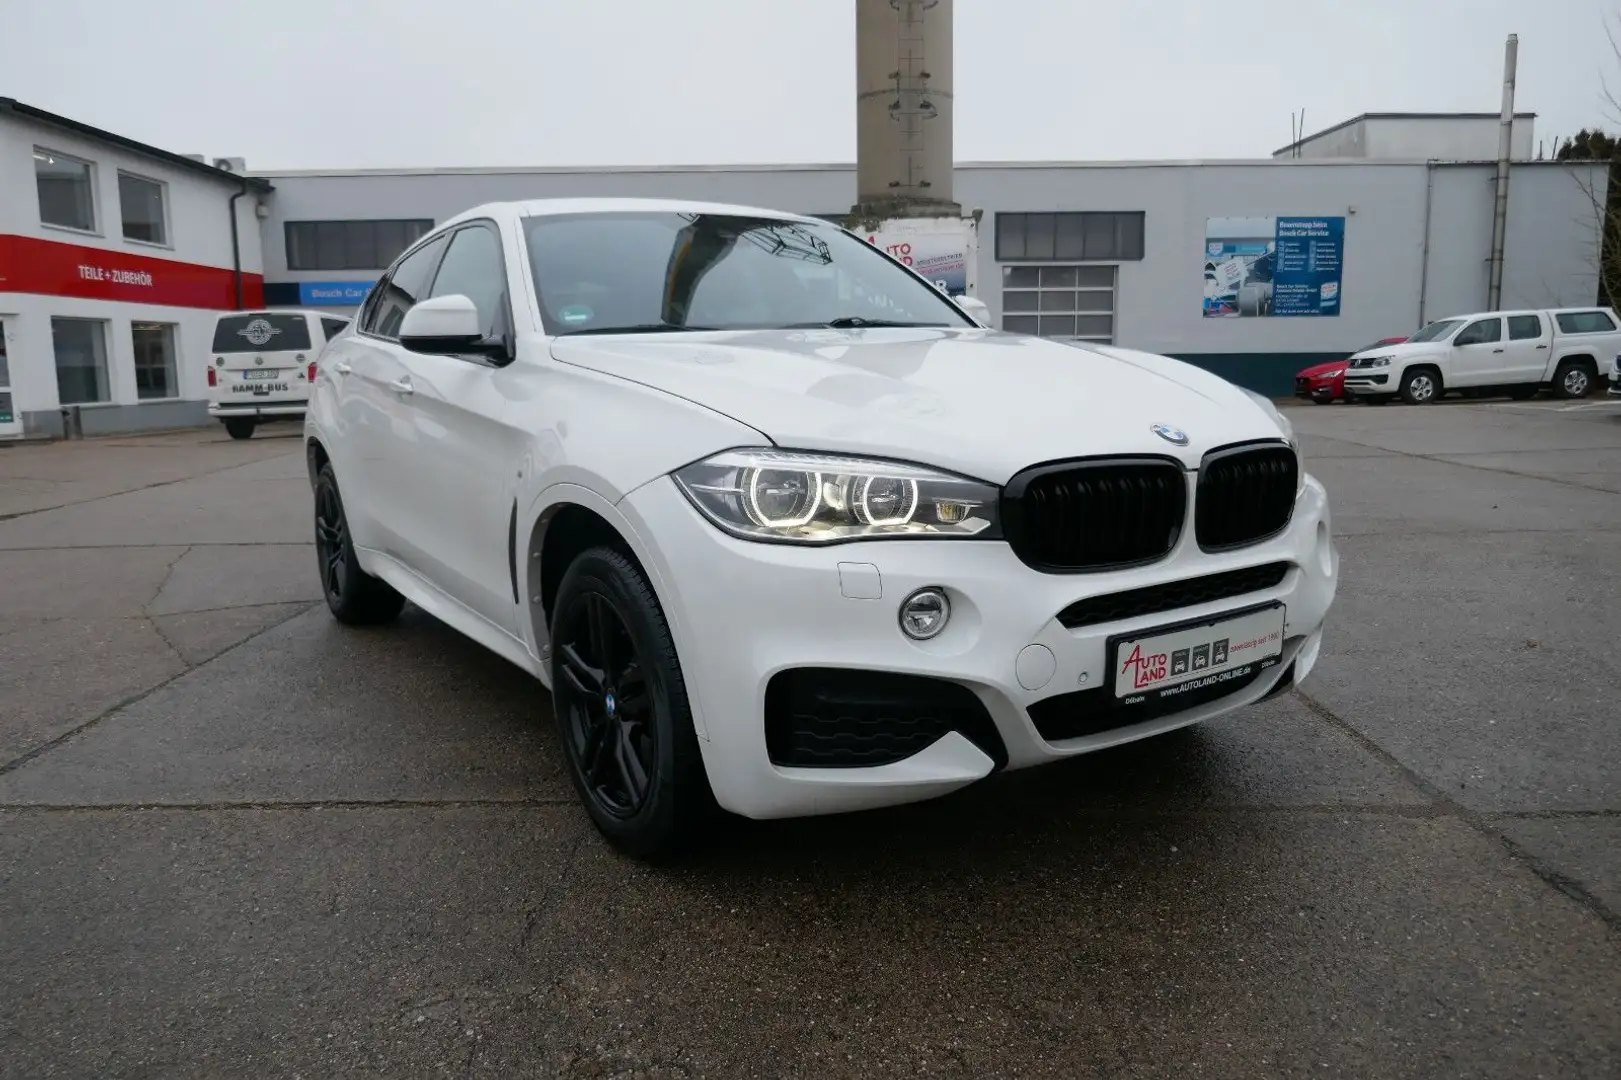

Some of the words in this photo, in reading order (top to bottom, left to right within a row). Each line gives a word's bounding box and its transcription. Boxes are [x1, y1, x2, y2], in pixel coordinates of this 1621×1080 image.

[78, 265, 104, 281] TEILE
[111, 269, 153, 286] ZUBEHÖR
[311, 289, 342, 298] Bosch
[345, 288, 362, 297] Car
[1122, 644, 1167, 675] AUTO
[1134, 664, 1167, 689] LAND
[1160, 667, 1251, 697] www.AUTOLAND-ONLINE.de
